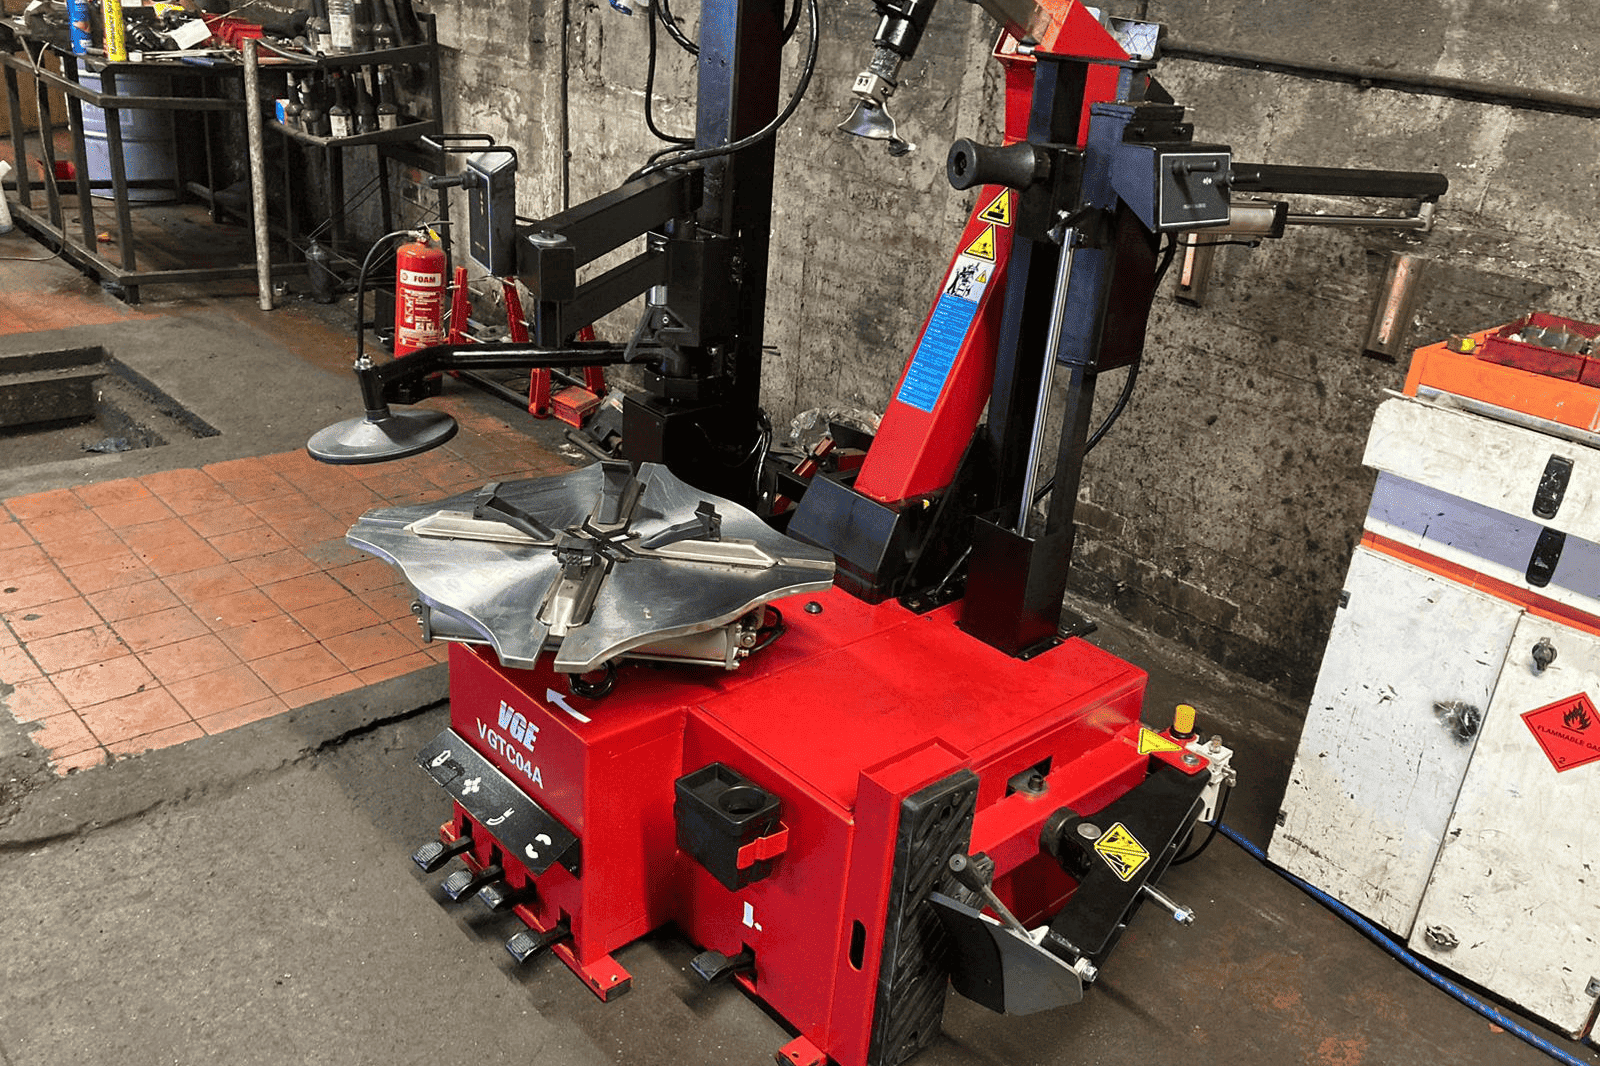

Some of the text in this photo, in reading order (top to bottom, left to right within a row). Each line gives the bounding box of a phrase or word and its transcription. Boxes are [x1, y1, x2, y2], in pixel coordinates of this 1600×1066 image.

[413, 275, 436, 283] FOAM
[498, 700, 539, 752] VGE
[1537, 725, 1584, 746] FLAMMABLE
[476, 716, 544, 789] VGTC04A
[1558, 756, 1566, 764] 2
